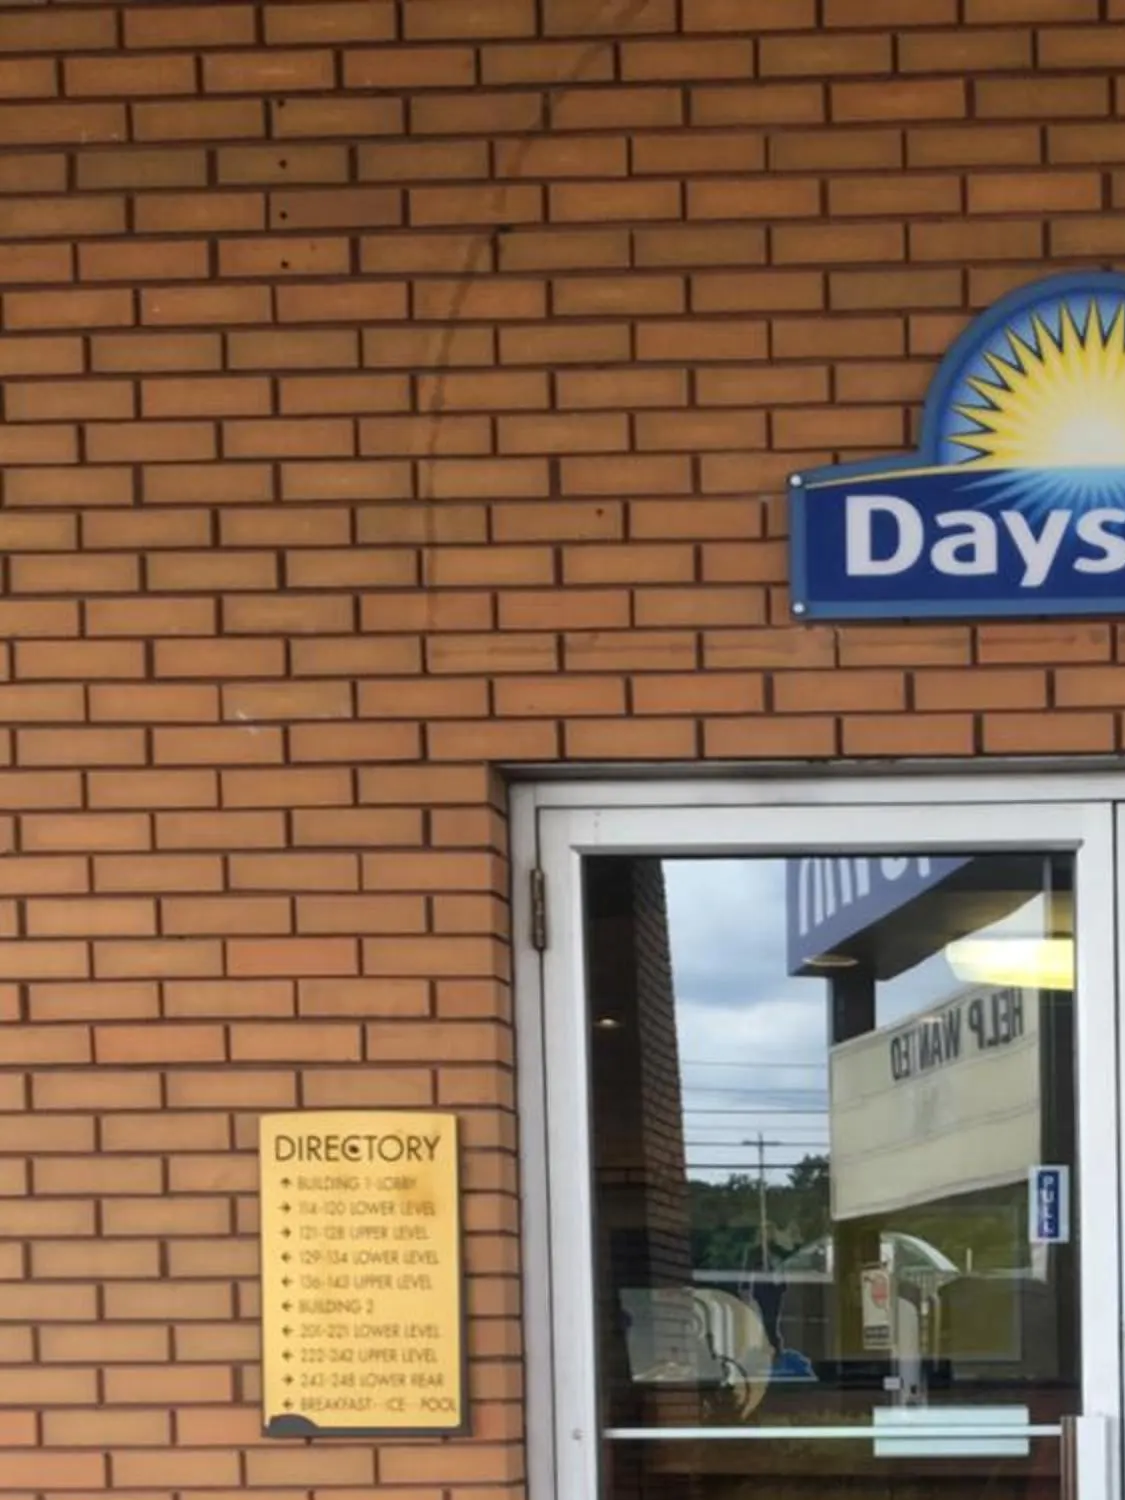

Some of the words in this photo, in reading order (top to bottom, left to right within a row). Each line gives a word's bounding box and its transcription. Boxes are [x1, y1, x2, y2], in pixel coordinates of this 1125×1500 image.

[275, 1134, 441, 1162] DIRECTORY
[297, 1175, 360, 1191] BUILDING
[350, 1200, 395, 1216] LOWER
[400, 1200, 436, 1216] LEVEL
[1040, 1174, 1055, 1236] PULL
[350, 1225, 388, 1240] UPPER
[393, 1225, 430, 1240] LEVEL
[353, 1250, 399, 1265] LOWER
[403, 1250, 439, 1265] LEVEL
[353, 1273, 393, 1290] UPPER
[397, 1273, 433, 1290] LEVEL
[298, 1298, 364, 1314] BUILDING
[353, 1323, 401, 1338] LOWER
[404, 1323, 441, 1338] LEVEL
[358, 1347, 397, 1363] UPPER
[402, 1347, 438, 1363] LEVEL
[360, 1372, 406, 1388] LOWER
